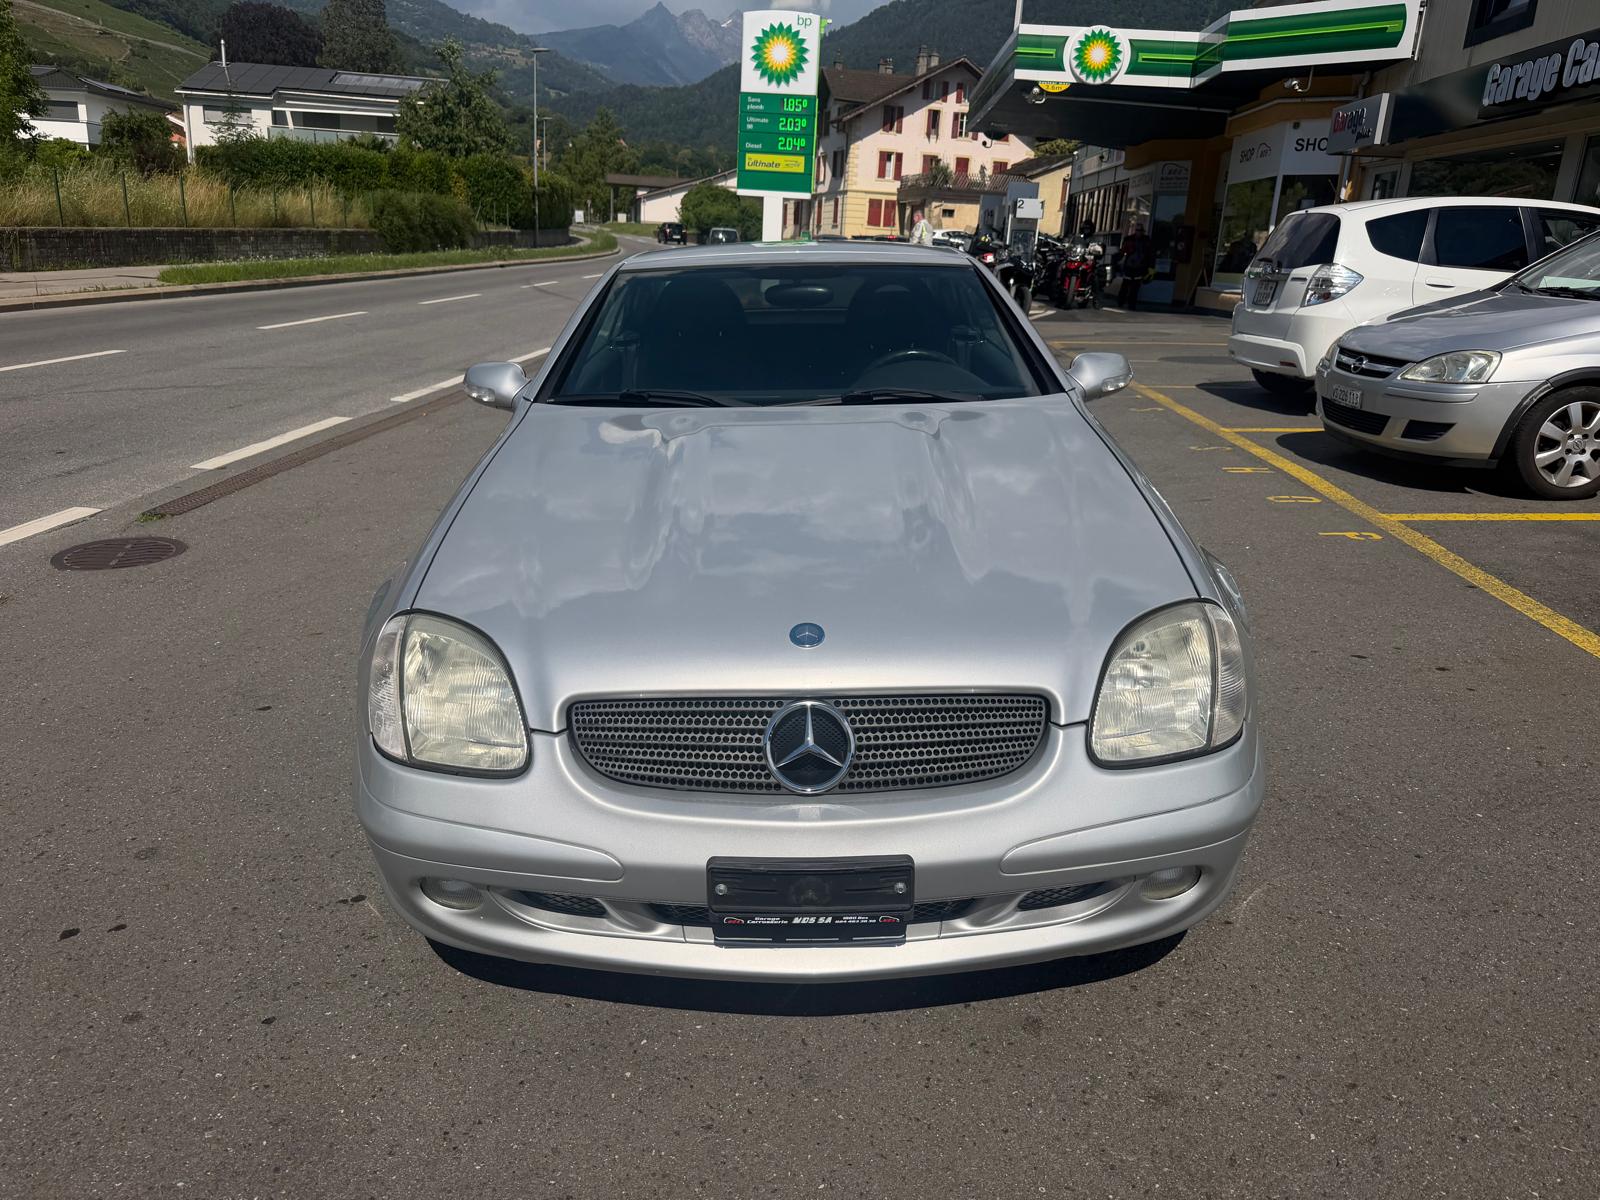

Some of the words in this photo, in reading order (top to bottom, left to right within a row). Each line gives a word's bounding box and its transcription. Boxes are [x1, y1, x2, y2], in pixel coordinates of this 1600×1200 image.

[797, 14, 812, 29] bp
[1482, 53, 1562, 107] Garage
[1333, 108, 1367, 134] Garage
[1294, 137, 1328, 152] SHO
[1240, 147, 1256, 163] SHOP
[1017, 199, 1025, 209] 2
[817, 916, 833, 924] SA
